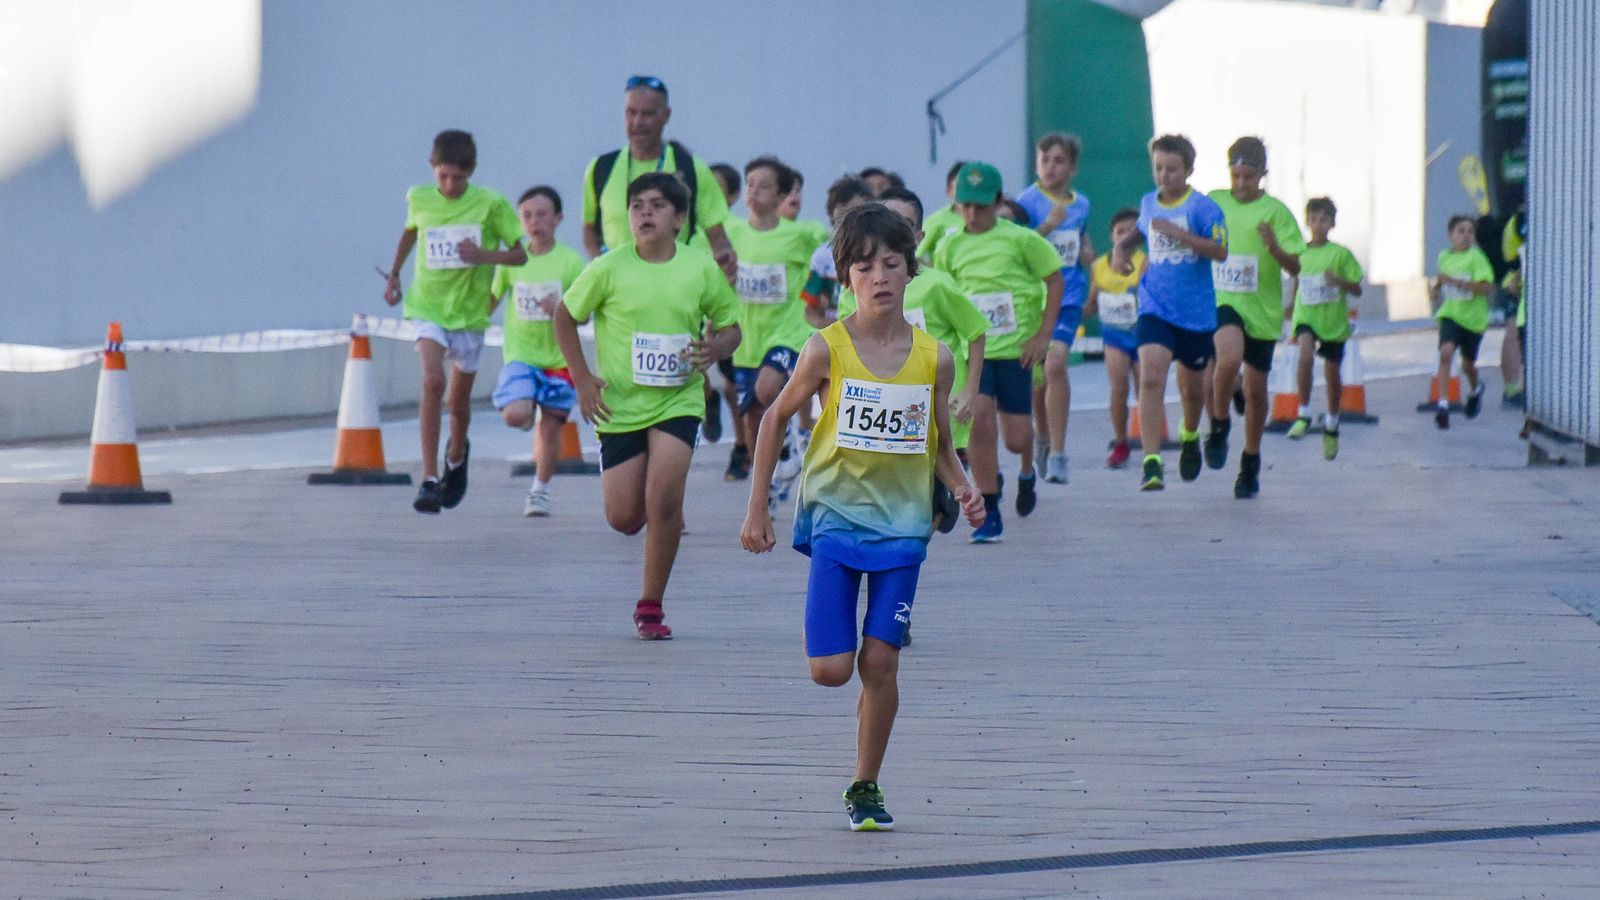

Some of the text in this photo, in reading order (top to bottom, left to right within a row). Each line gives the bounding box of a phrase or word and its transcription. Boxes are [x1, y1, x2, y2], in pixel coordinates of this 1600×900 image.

[636, 351, 677, 372] 1026
[846, 385, 863, 397] XXI
[845, 405, 902, 433] 1545
